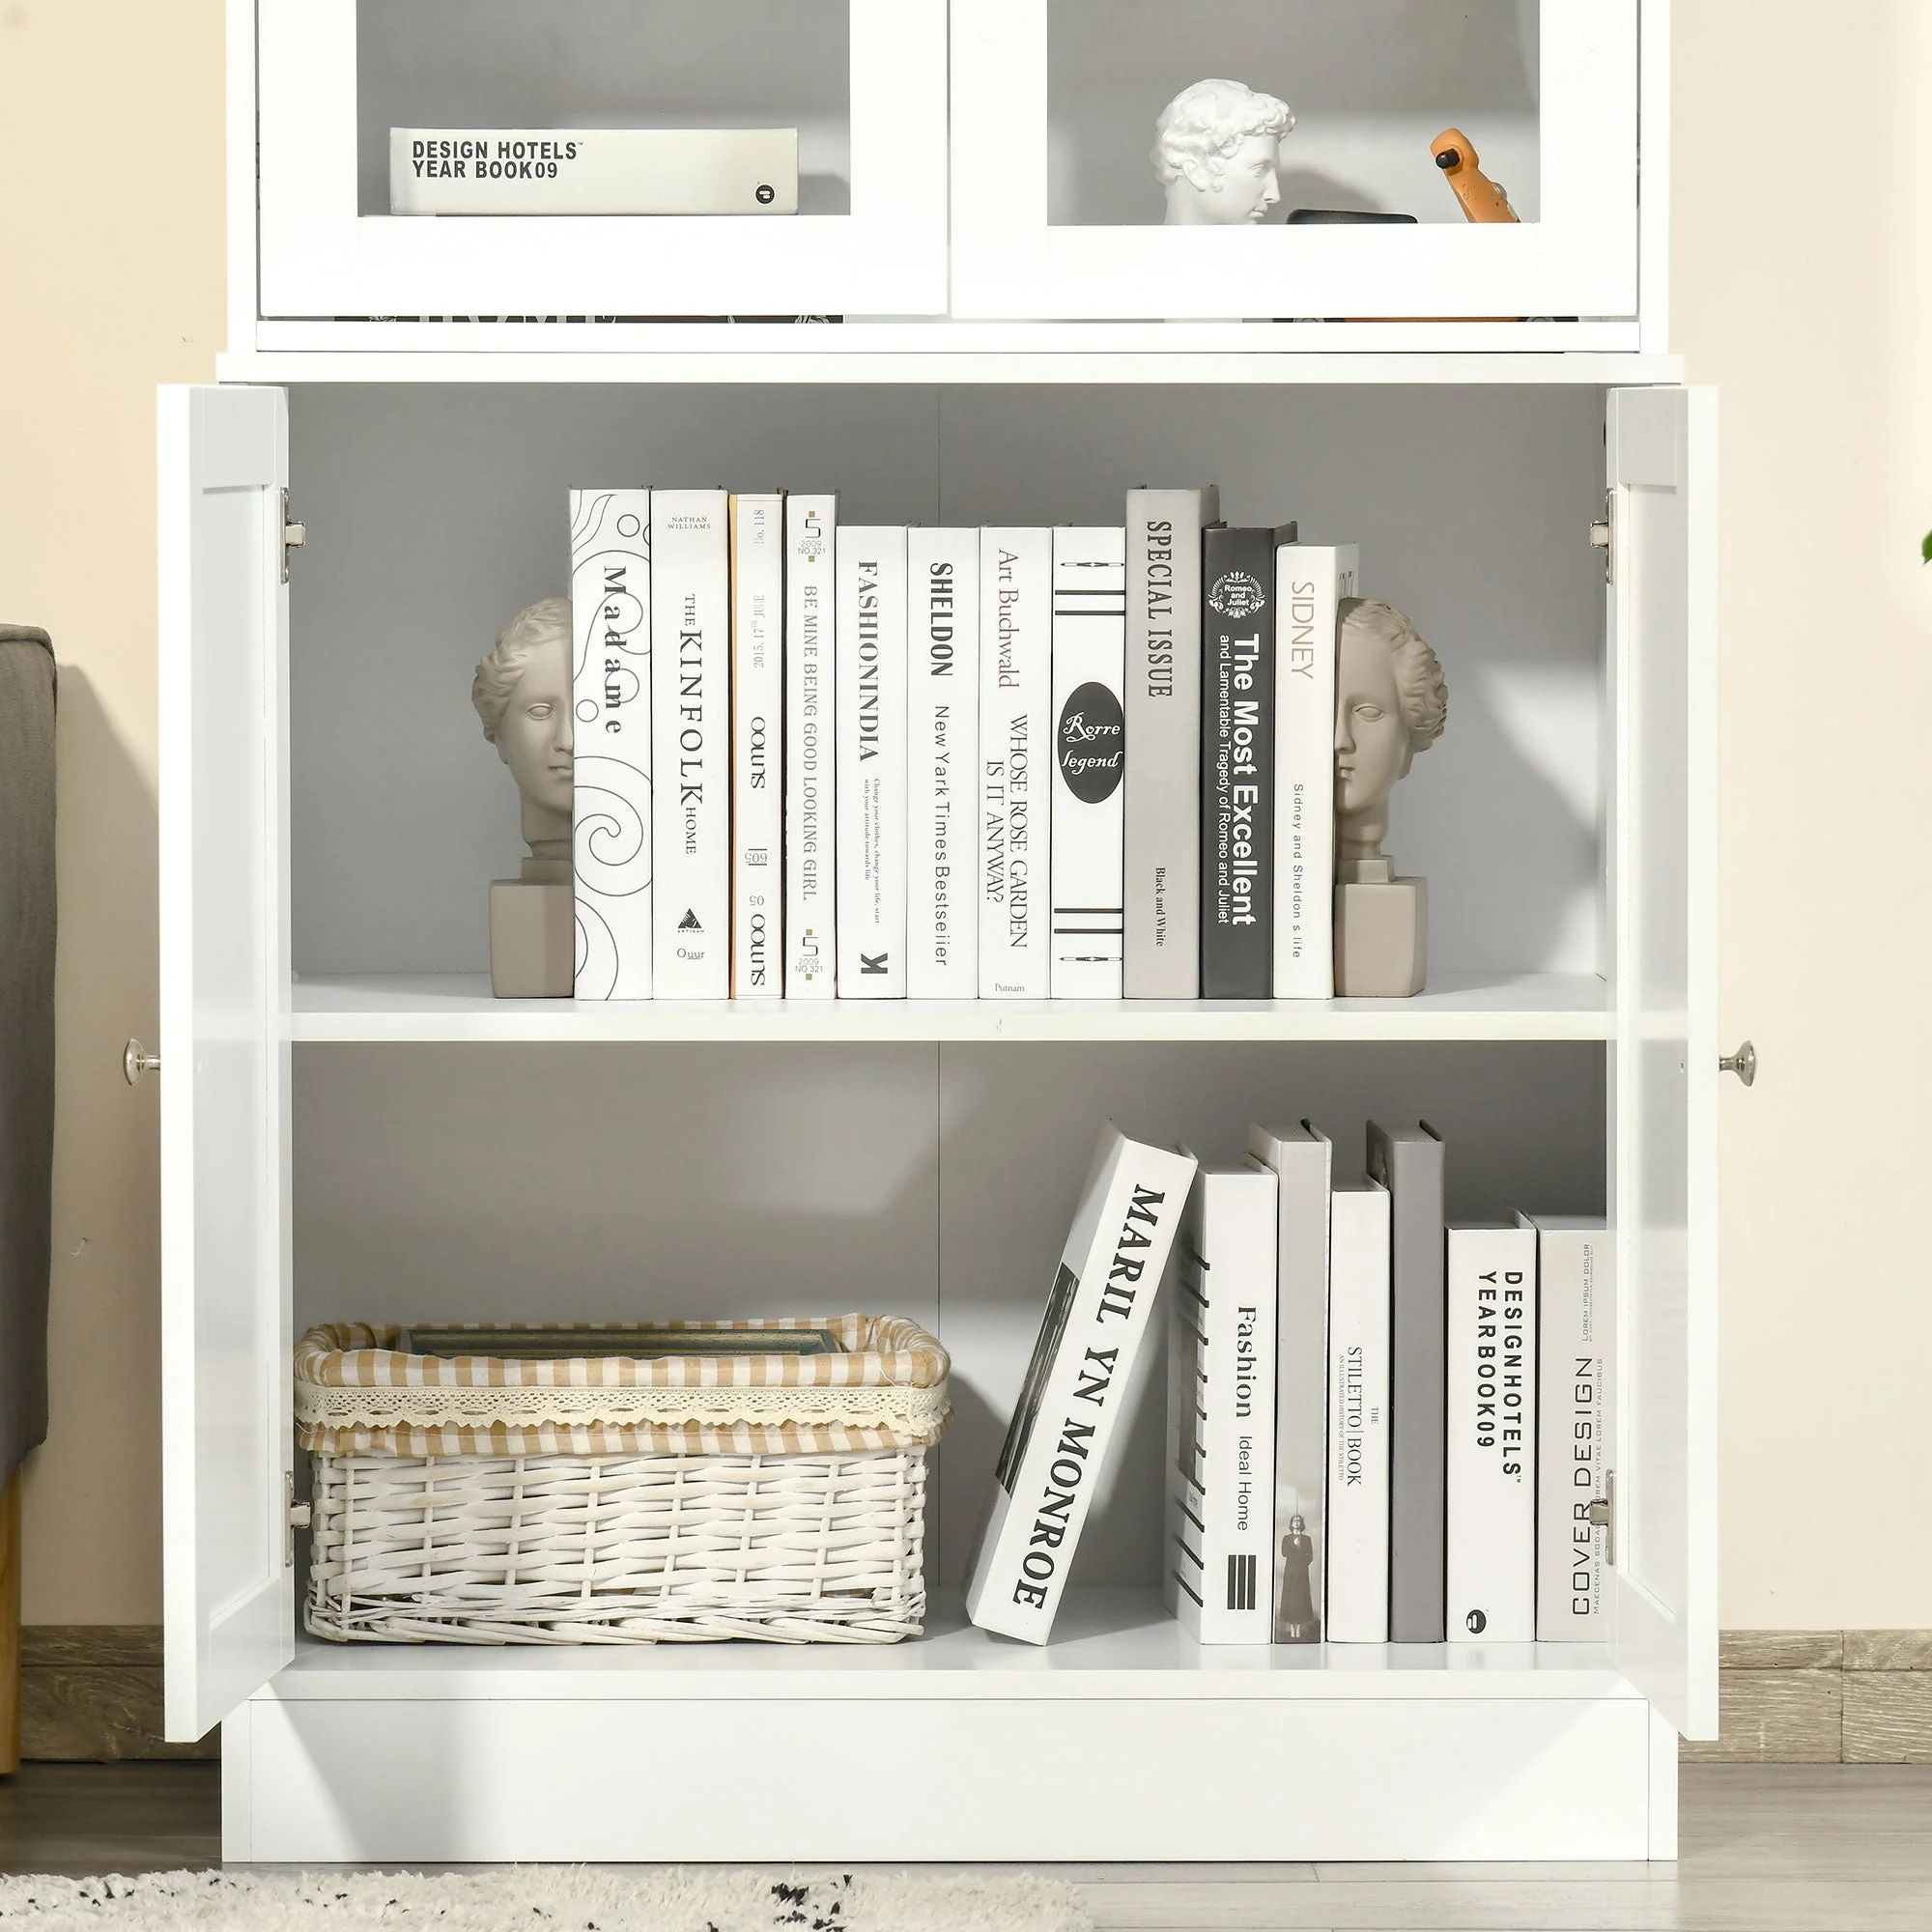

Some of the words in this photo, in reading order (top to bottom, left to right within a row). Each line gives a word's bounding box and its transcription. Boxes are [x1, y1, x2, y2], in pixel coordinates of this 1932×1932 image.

[412, 140, 488, 159] DESIGN
[412, 160, 467, 179] YEAR
[475, 161, 558, 180] BOOK09
[998, 548, 1019, 582] Art
[1147, 521, 1173, 620] SPECIAL
[684, 593, 696, 627] THE
[804, 585, 818, 609] BE
[929, 562, 954, 676] SHELDON
[1227, 598, 1250, 607] Juliet
[603, 565, 628, 734] Madame
[803, 615, 818, 656] MINE
[998, 589, 1020, 688] Buchwald
[1219, 635, 1233, 659] and
[1291, 581, 1315, 680] SIDNEY
[1147, 629, 1174, 697] ISSUE
[1234, 633, 1260, 691] The
[803, 664, 818, 716] BEING
[1219, 663, 1232, 737] Lamentable
[679, 630, 703, 806] KINFOLK
[934, 705, 950, 747] New
[1233, 700, 1260, 775] Most
[803, 723, 817, 770] GOOD
[986, 760, 1005, 777] IS
[1009, 714, 1028, 792] WHOSE
[1061, 749, 1123, 776] legend
[1215, 741, 1232, 792] Tragedy
[803, 778, 817, 853] LOOKING
[986, 784, 1005, 805] IT
[1218, 796, 1232, 810] of
[1292, 783, 1304, 830] Sidney
[684, 806, 697, 855] HOME
[934, 802, 951, 860] Times
[1009, 801, 1028, 853] ROSE
[1218, 812, 1231, 858] Romeo
[1293, 835, 1303, 859] and
[986, 811, 1005, 903] ANYWAY?
[1218, 862, 1231, 886] and
[1232, 784, 1259, 925] Excellent
[803, 859, 817, 900] GIRL
[1155, 867, 1166, 895] Black
[1293, 865, 1304, 919] Sheldon
[1009, 861, 1028, 949] GARDEN
[1155, 897, 1166, 915] and
[1217, 889, 1231, 924] Juliet
[1155, 917, 1167, 947] White
[1293, 937, 1303, 958] life
[994, 982, 1025, 992] Putnam
[1583, 1243, 1592, 1275] DOLOR
[1582, 1279, 1591, 1307] IPSUM
[1581, 1310, 1591, 1342] LOREM
[1236, 1306, 1258, 1418] Fashion
[1347, 1347, 1363, 1428] STILETTO
[1370, 1406, 1379, 1425] THE
[1573, 1357, 1593, 1488] DESIGN
[1238, 1435, 1253, 1475] Ideal
[1347, 1437, 1362, 1487] BOOK
[1012, 1416, 1095, 1609] MONROE
[1236, 1481, 1252, 1531] Home
[1572, 1502, 1591, 1615] COVER
